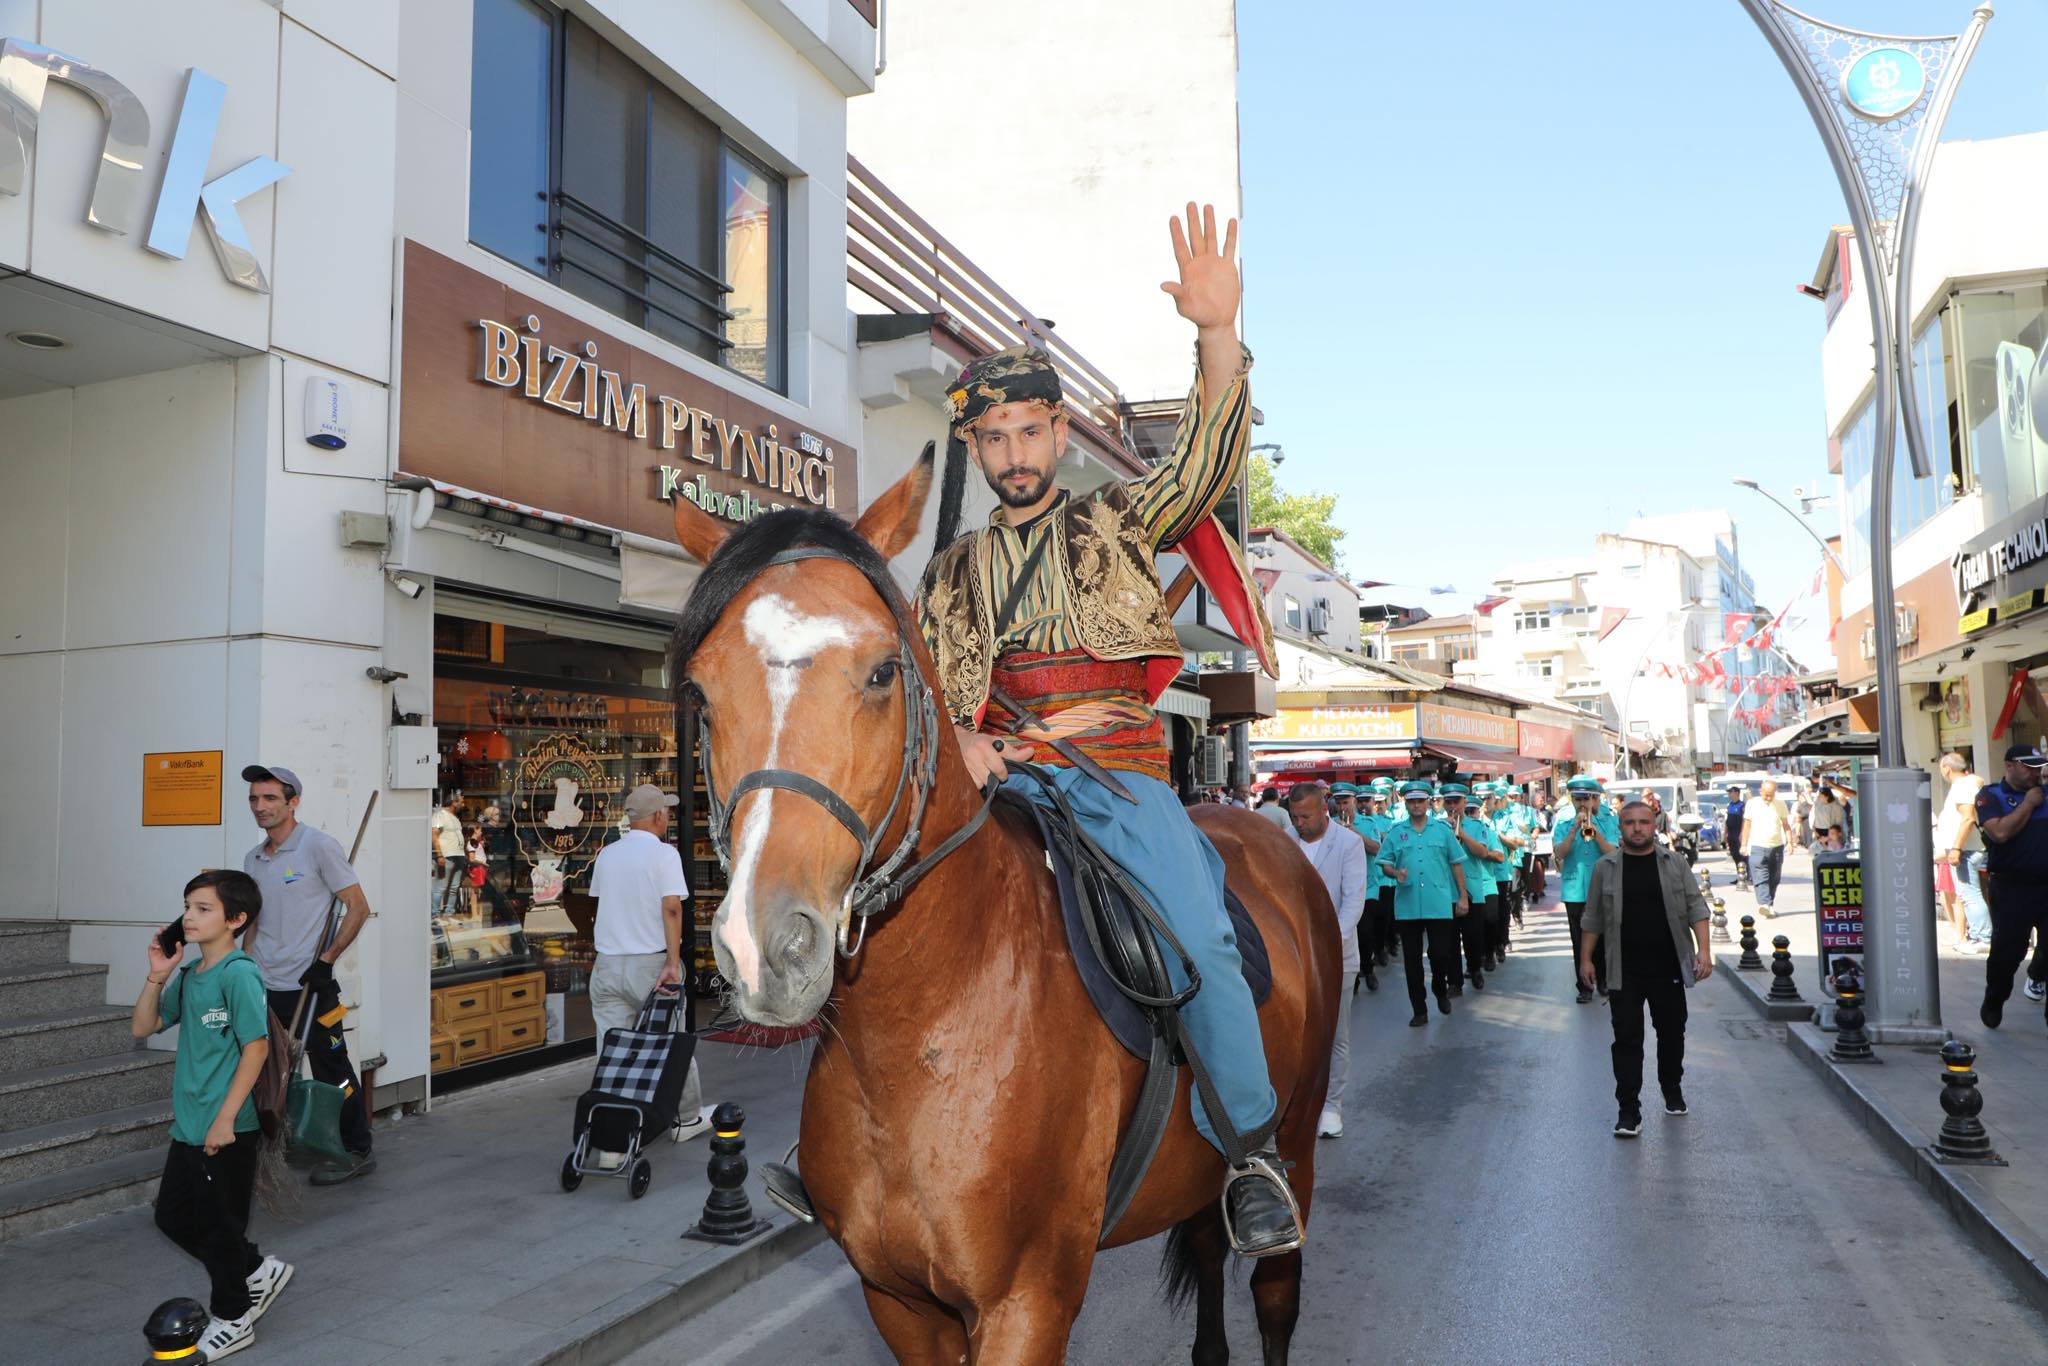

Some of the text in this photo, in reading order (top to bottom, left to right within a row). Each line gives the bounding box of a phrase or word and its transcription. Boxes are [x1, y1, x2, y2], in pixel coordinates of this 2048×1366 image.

[479, 314, 836, 509] BİZİM PEYNİRCİ
[801, 432, 824, 457] 1975
[660, 465, 768, 522] Kahvalt
[1962, 518, 2048, 592] H&M TECHNOL
[1312, 705, 1389, 720] MERAKLI
[1300, 721, 1403, 737] KURUYEMİŞ
[554, 833, 574, 848] 1975
[1820, 868, 1862, 885] TEK
[1822, 888, 1863, 905] SER
[1824, 909, 1861, 919] LAP
